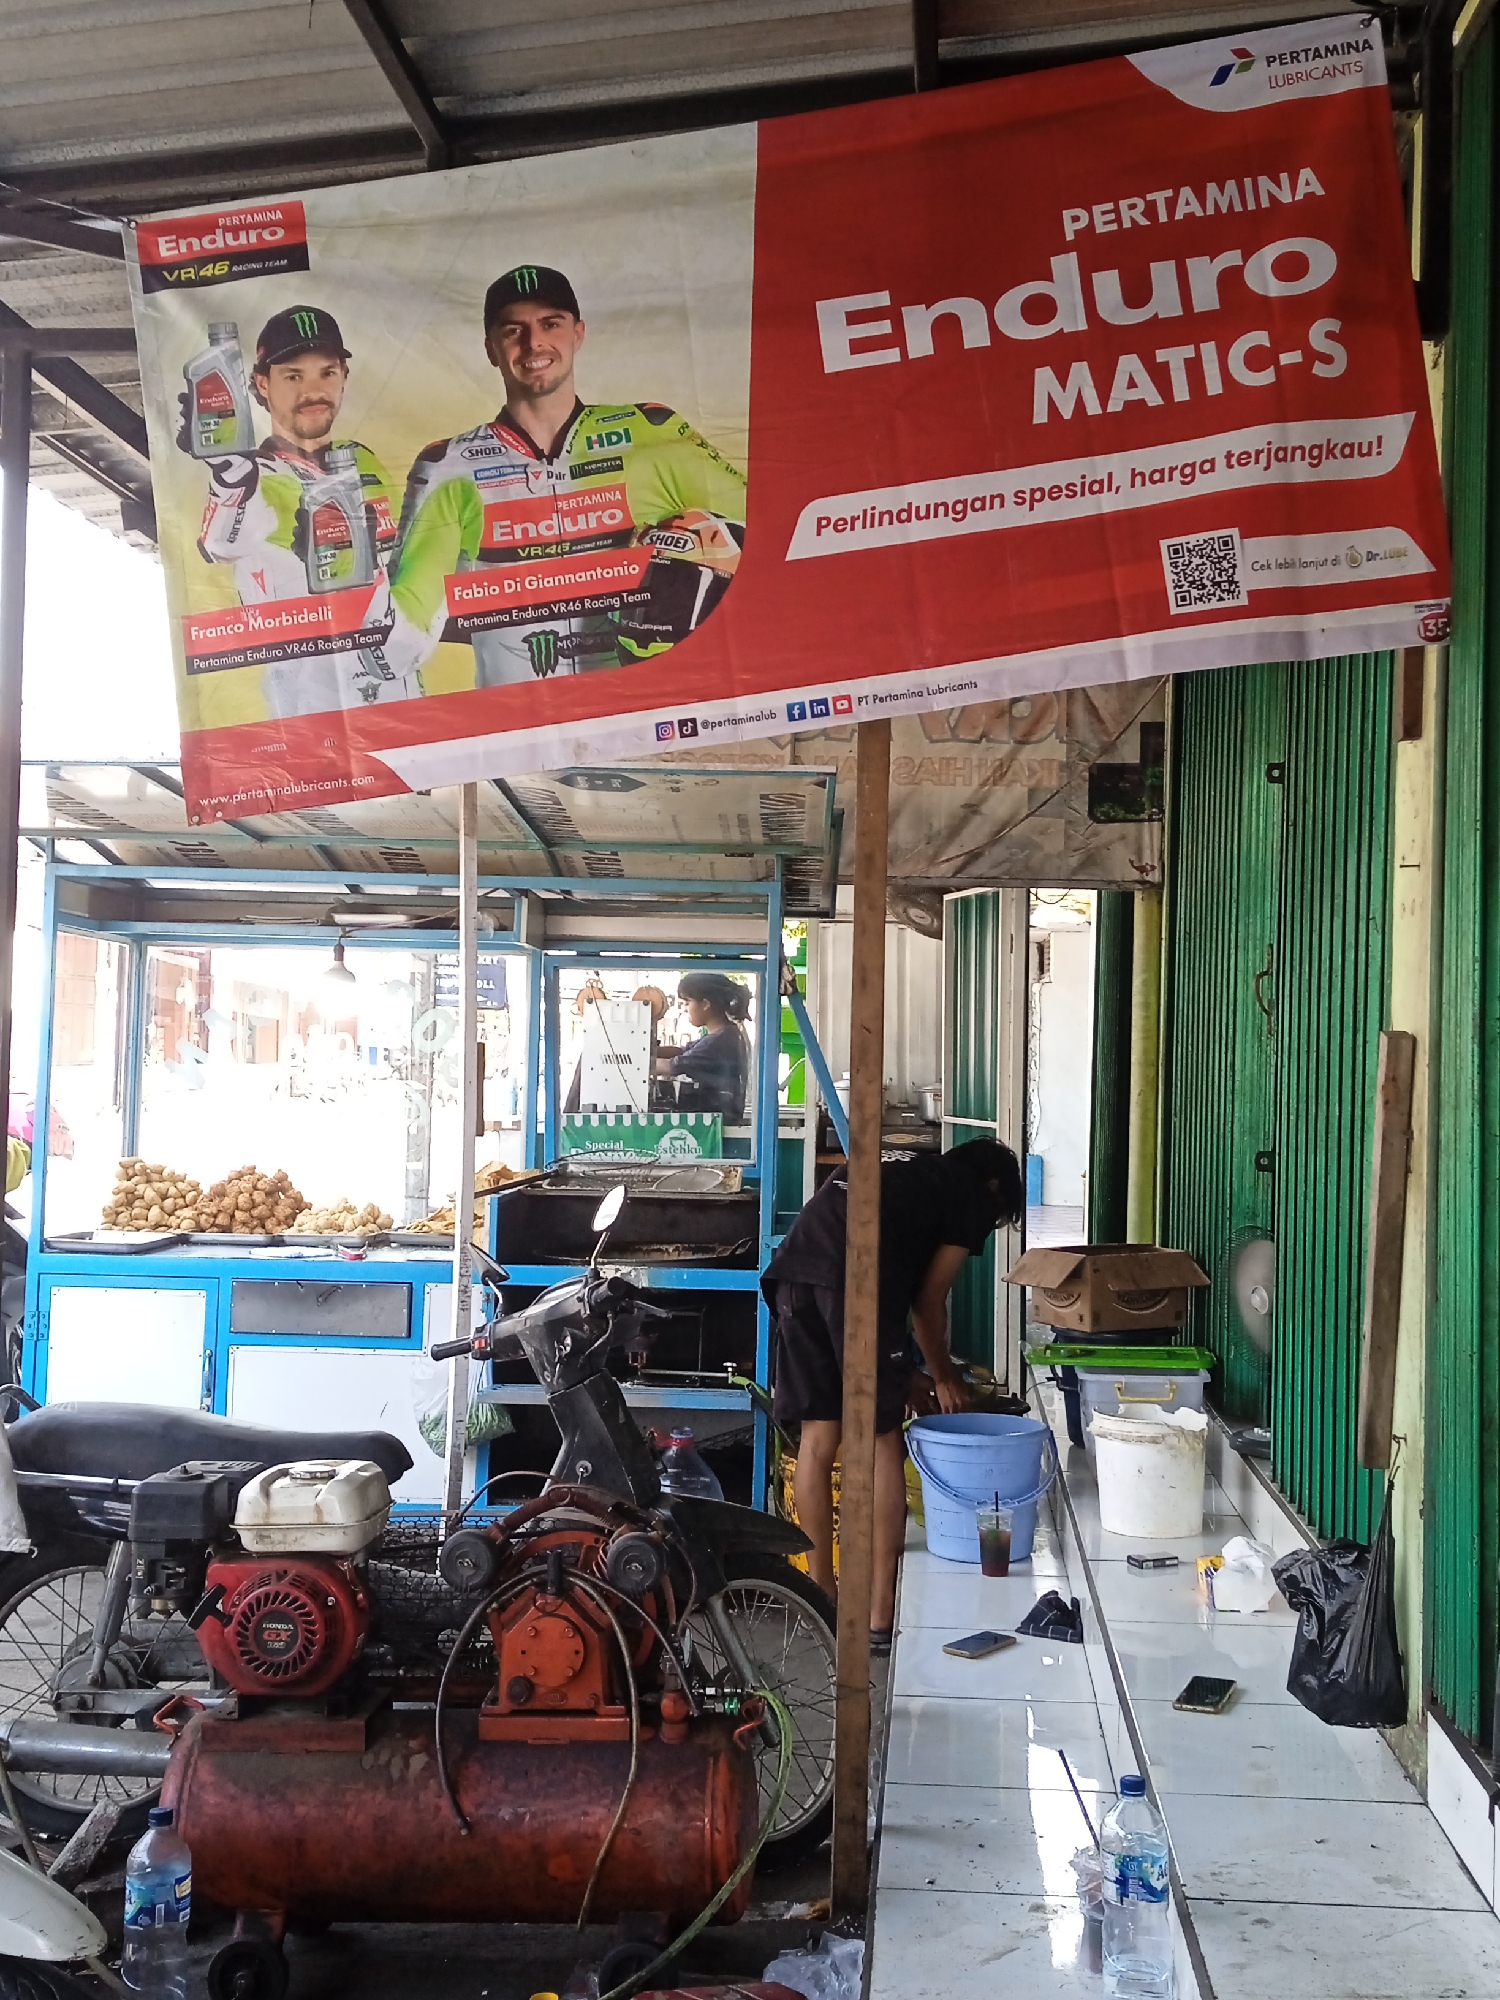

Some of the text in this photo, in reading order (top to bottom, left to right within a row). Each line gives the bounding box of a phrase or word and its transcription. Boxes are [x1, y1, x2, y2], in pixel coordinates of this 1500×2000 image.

[1266, 39, 1374, 67] PERTAMINA
[1268, 60, 1364, 89] LUBRICANTS
[1062, 166, 1325, 241] PERTAMINA
[218, 210, 283, 227] PERTAMINA
[157, 225, 285, 257] Enduro
[232, 261, 263, 272] RACING
[815, 236, 1338, 374] Enduro
[1032, 318, 1348, 424] MATIC-S
[468, 445, 502, 458] SHOEI
[585, 427, 632, 451] HDI
[815, 434, 1384, 537] Perlindungan spesial, harga terjangkau!
[555, 491, 622, 510] PERTAMINA
[493, 508, 623, 542] Enduro
[650, 533, 689, 549] SHOEI
[1251, 560, 1272, 572] Cek
[1275, 557, 1297, 571] lebih
[1299, 555, 1329, 572] lanjut
[1331, 555, 1341, 567] di
[453, 561, 640, 601] Fabio Di Giannantonio
[191, 606, 333, 641] Franco Morbidelli
[457, 591, 651, 629] Pertamina Enduro VR46 Racing Team
[193, 632, 383, 670] Pertamina Enduro VR46 Racing Team
[701, 710, 777, 731] @pertaminalub
[857, 695, 869, 707] PT
[873, 688, 923, 705] Pertamina
[926, 679, 978, 697] Lubricants
[199, 773, 375, 807] www.pertaminalubricants.com
[585, 1139, 624, 1151] Special
[655, 1143, 703, 1156] Estehku
[262, 1622, 294, 1631] HONDA
[262, 1630, 292, 1642] GX
